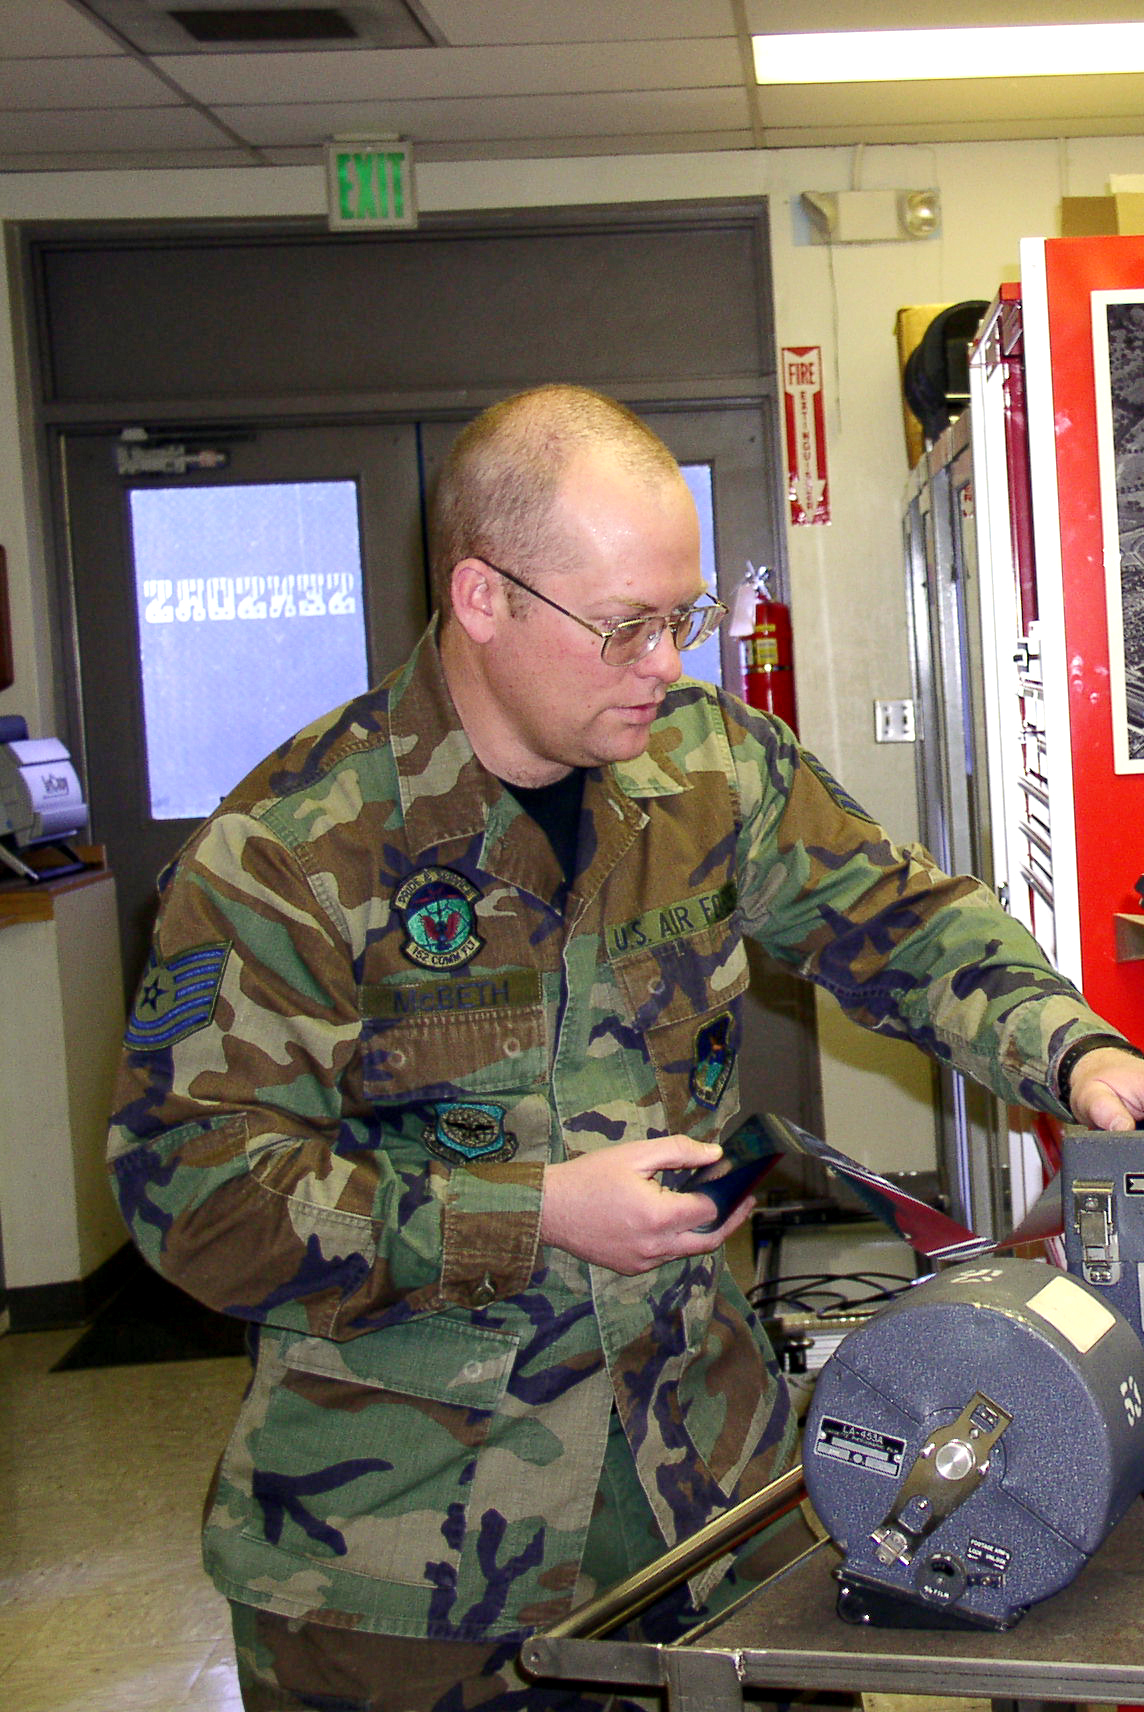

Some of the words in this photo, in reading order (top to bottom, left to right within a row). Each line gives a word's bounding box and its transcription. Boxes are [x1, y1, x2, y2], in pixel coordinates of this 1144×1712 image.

[336, 152, 405, 219] EXIT
[788, 363, 816, 386] FIRE
[614, 920, 652, 951] U.S.
[659, 906, 695, 938] AIR
[412, 945, 430, 960] 152
[394, 979, 510, 1014] McBETH
[843, 1425, 884, 1446] LA-453A
[968, 1547, 982, 1557] LOCK
[933, 1588, 950, 1599] FILM
